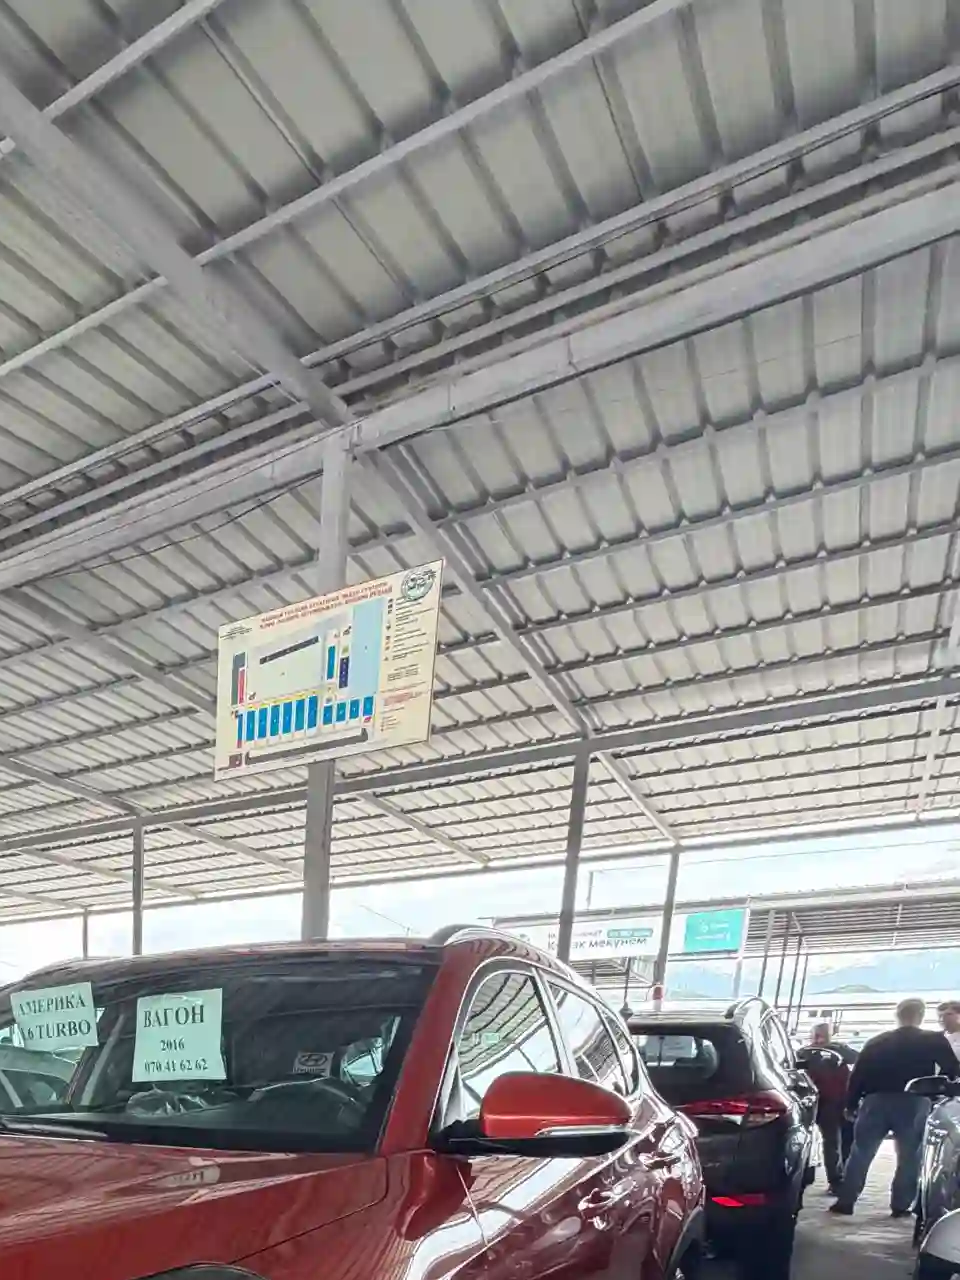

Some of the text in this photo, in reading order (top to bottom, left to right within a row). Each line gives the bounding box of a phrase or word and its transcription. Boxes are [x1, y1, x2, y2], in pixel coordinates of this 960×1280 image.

[18, 991, 87, 1016] АМЕРИКА
[143, 1004, 204, 1028] ВАГОН
[36, 1019, 92, 1040] TURBO
[160, 1038, 185, 1052] 2016
